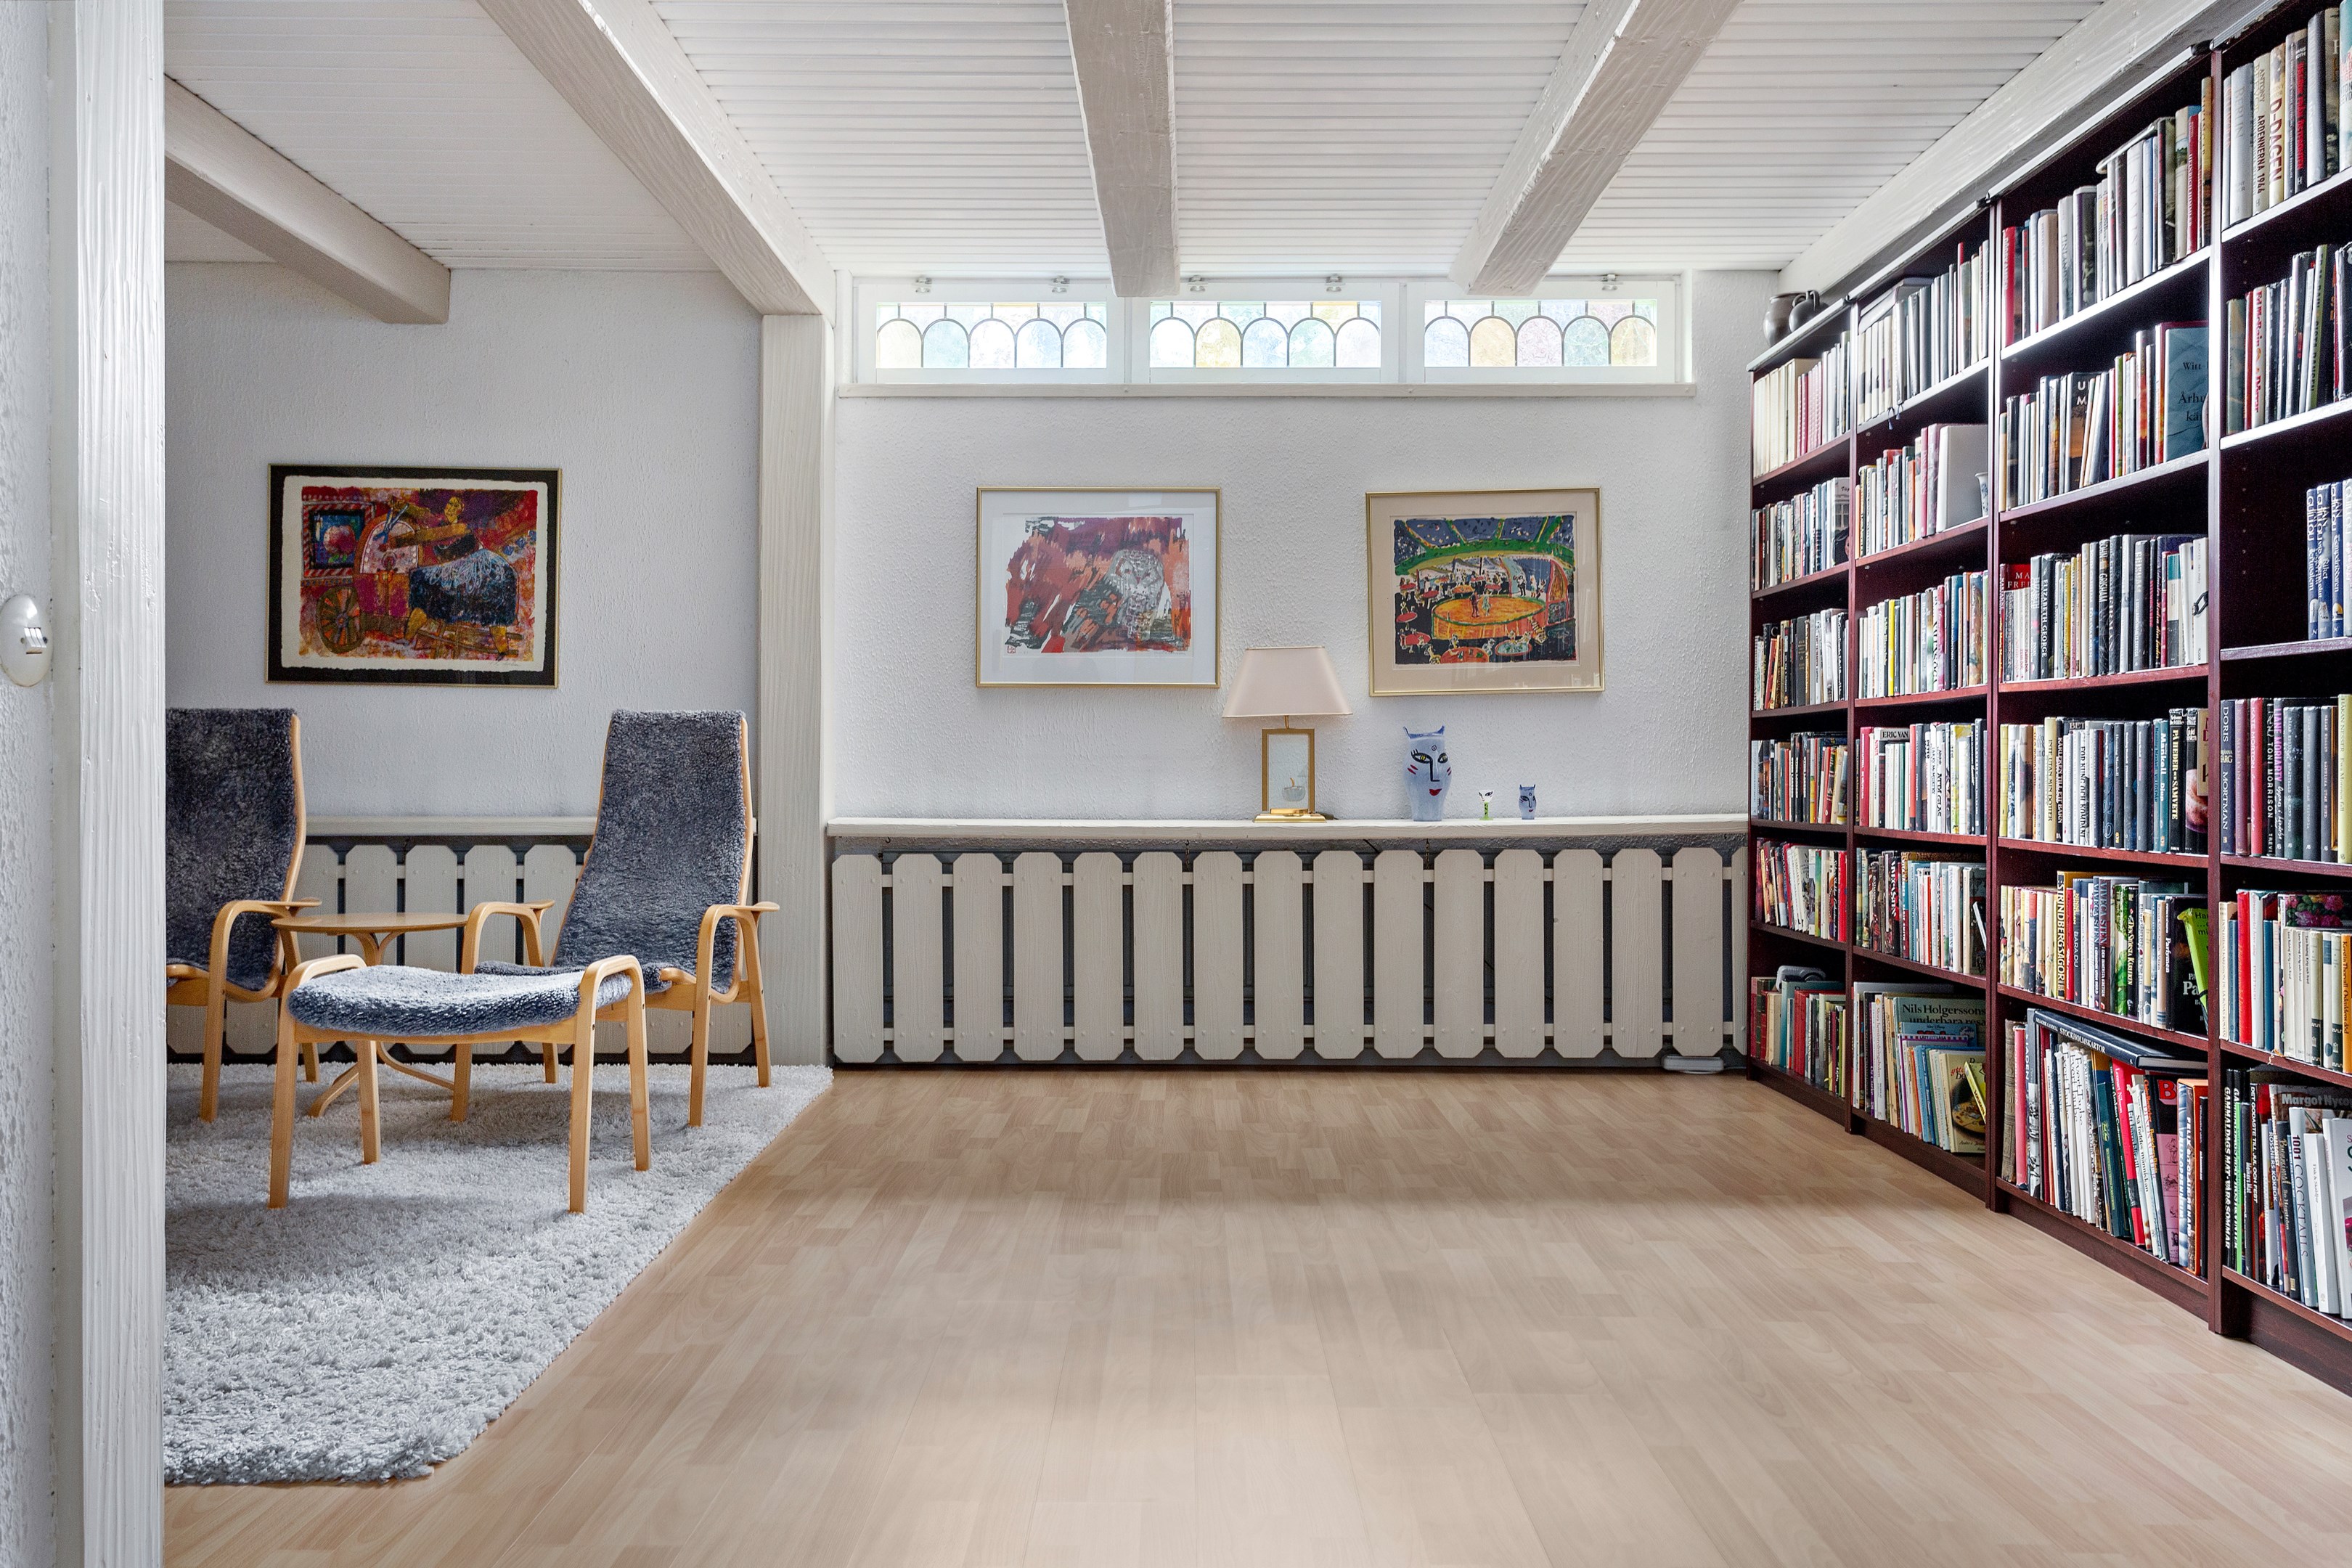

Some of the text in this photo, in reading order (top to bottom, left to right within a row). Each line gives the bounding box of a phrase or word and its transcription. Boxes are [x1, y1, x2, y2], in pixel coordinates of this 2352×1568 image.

[2269, 97, 2282, 184] D-DAGEN
[2099, 573, 2108, 603] GRISHAM
[2171, 730, 2179, 740] PÅ
[2274, 707, 2283, 782] LIANE MORIARTY
[2074, 955, 2078, 968] DU
[1902, 1003, 1986, 1018] Nils Holgerssons
[2075, 1056, 2083, 1088] Evert
[2281, 1093, 2323, 1107] Margot
[2292, 1135, 2308, 1258] 1001 COCKTAILS
